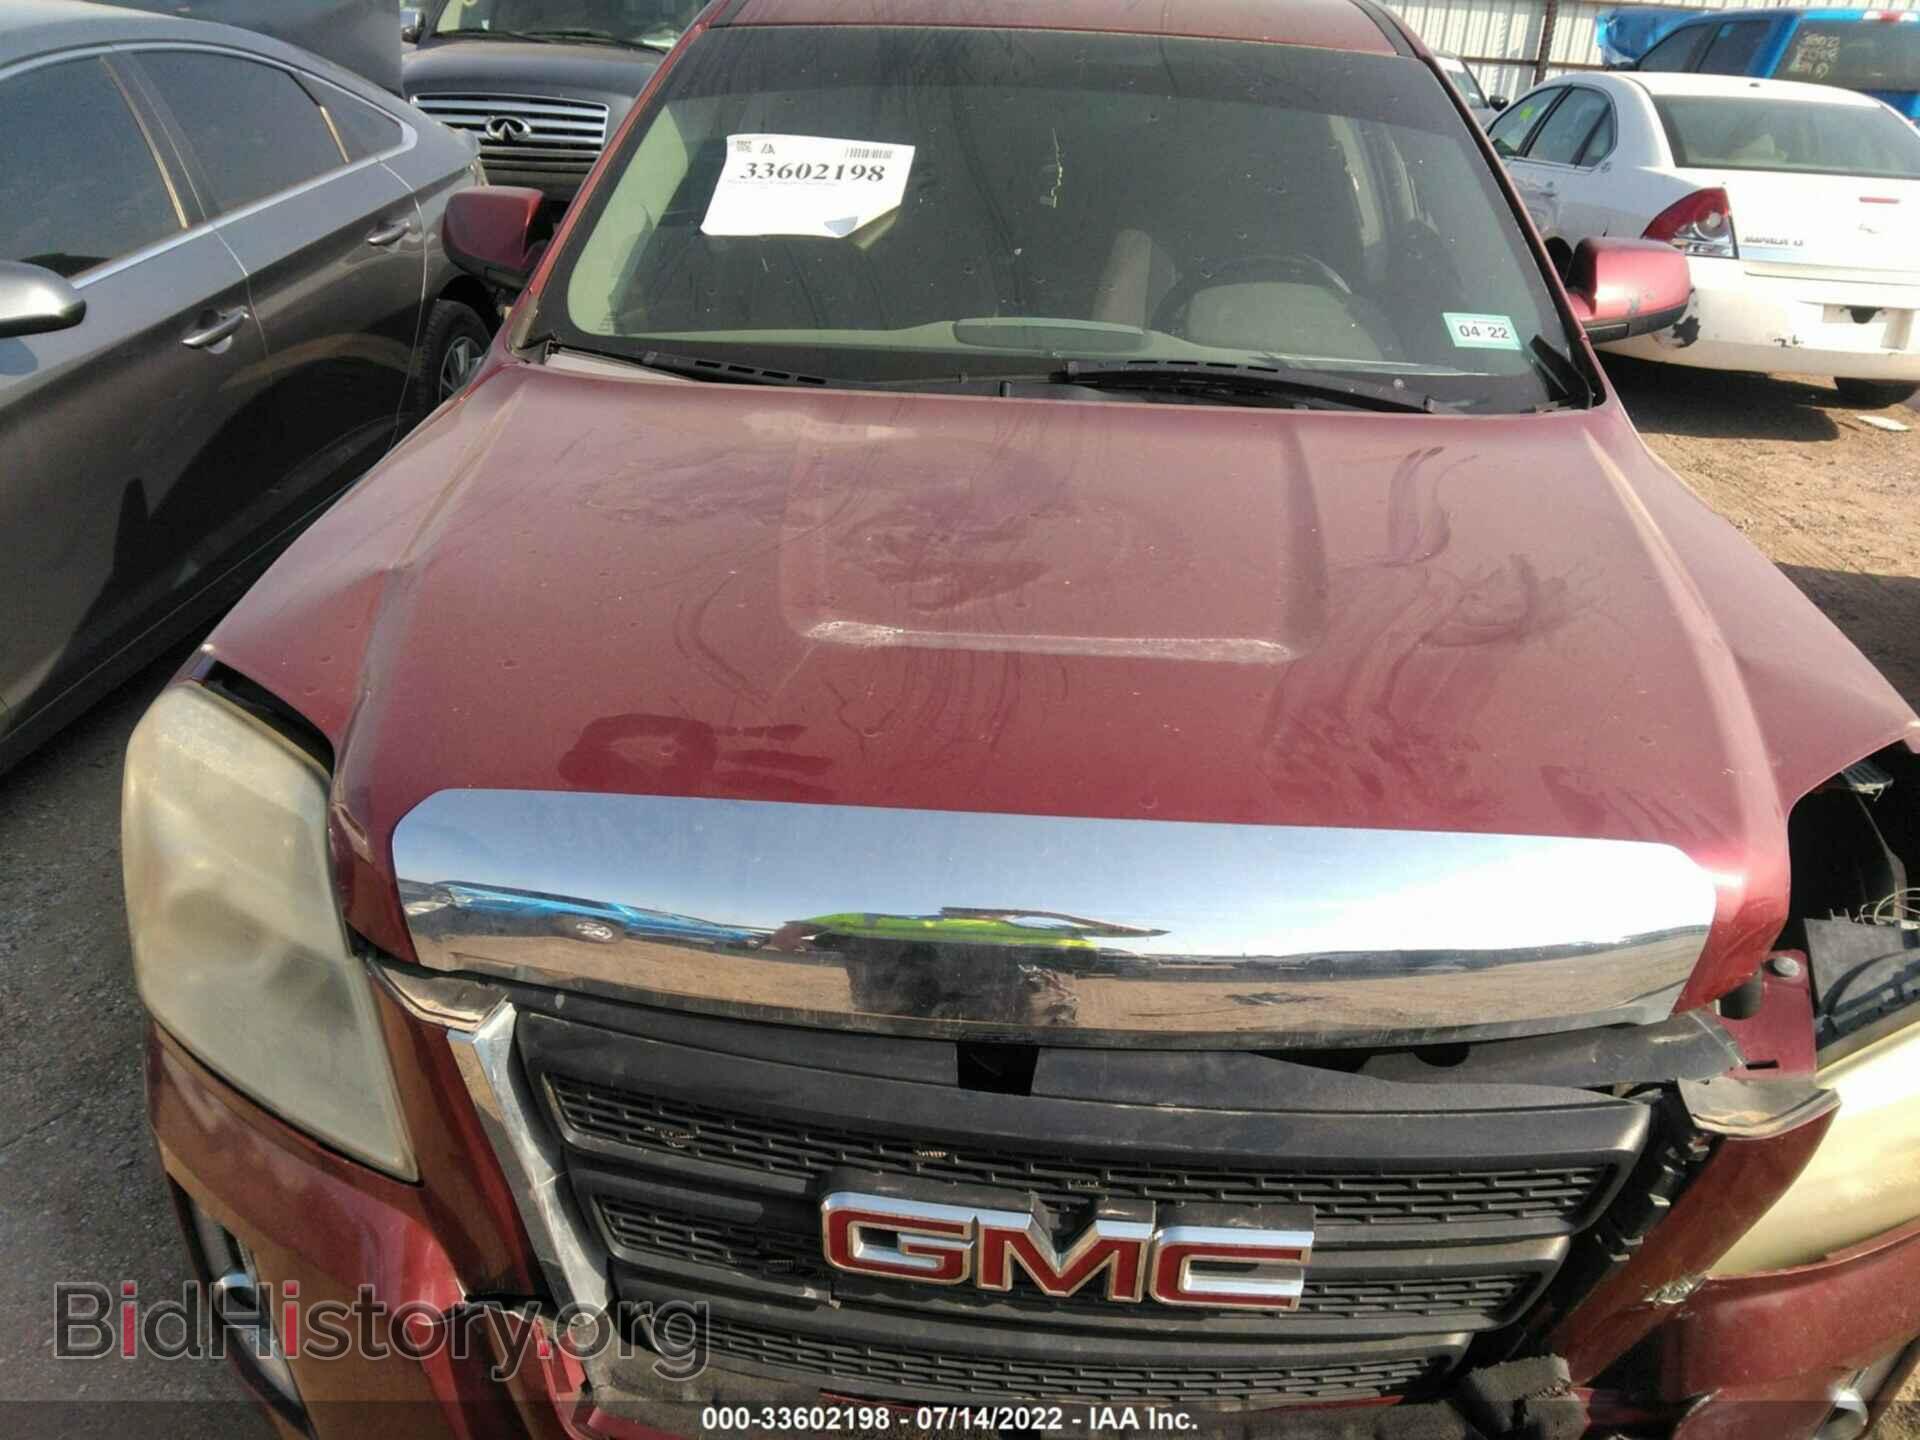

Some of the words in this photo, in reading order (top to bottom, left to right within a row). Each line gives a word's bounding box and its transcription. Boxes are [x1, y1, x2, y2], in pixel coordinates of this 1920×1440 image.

[740, 162, 886, 181] 33602198
[1460, 325, 1480, 337] 04
[1488, 327, 1511, 339] 22
[820, 1191, 1315, 1312] GMC
